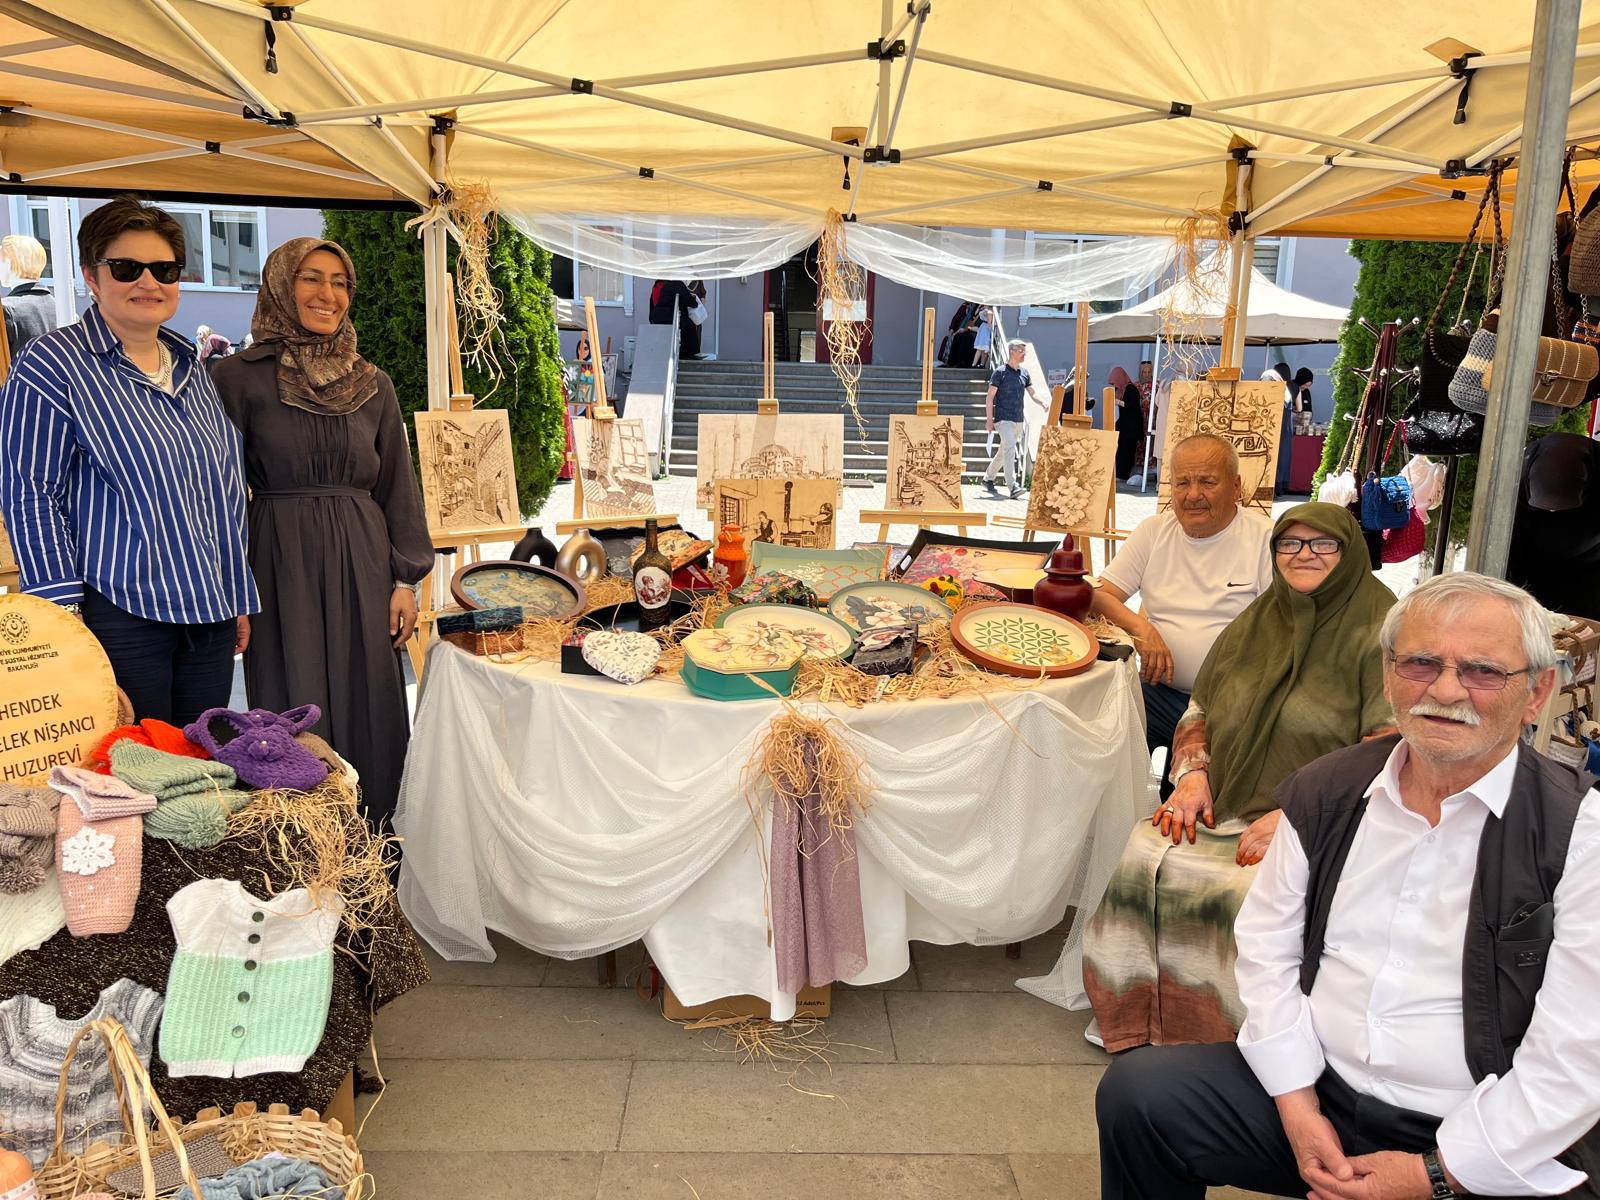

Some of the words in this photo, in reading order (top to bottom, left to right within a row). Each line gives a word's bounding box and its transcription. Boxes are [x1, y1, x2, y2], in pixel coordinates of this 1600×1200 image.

[0, 693, 62, 721] HENDEK
[34, 715, 95, 743] NİŞANCI
[3, 744, 82, 781] HUZUREVİ
